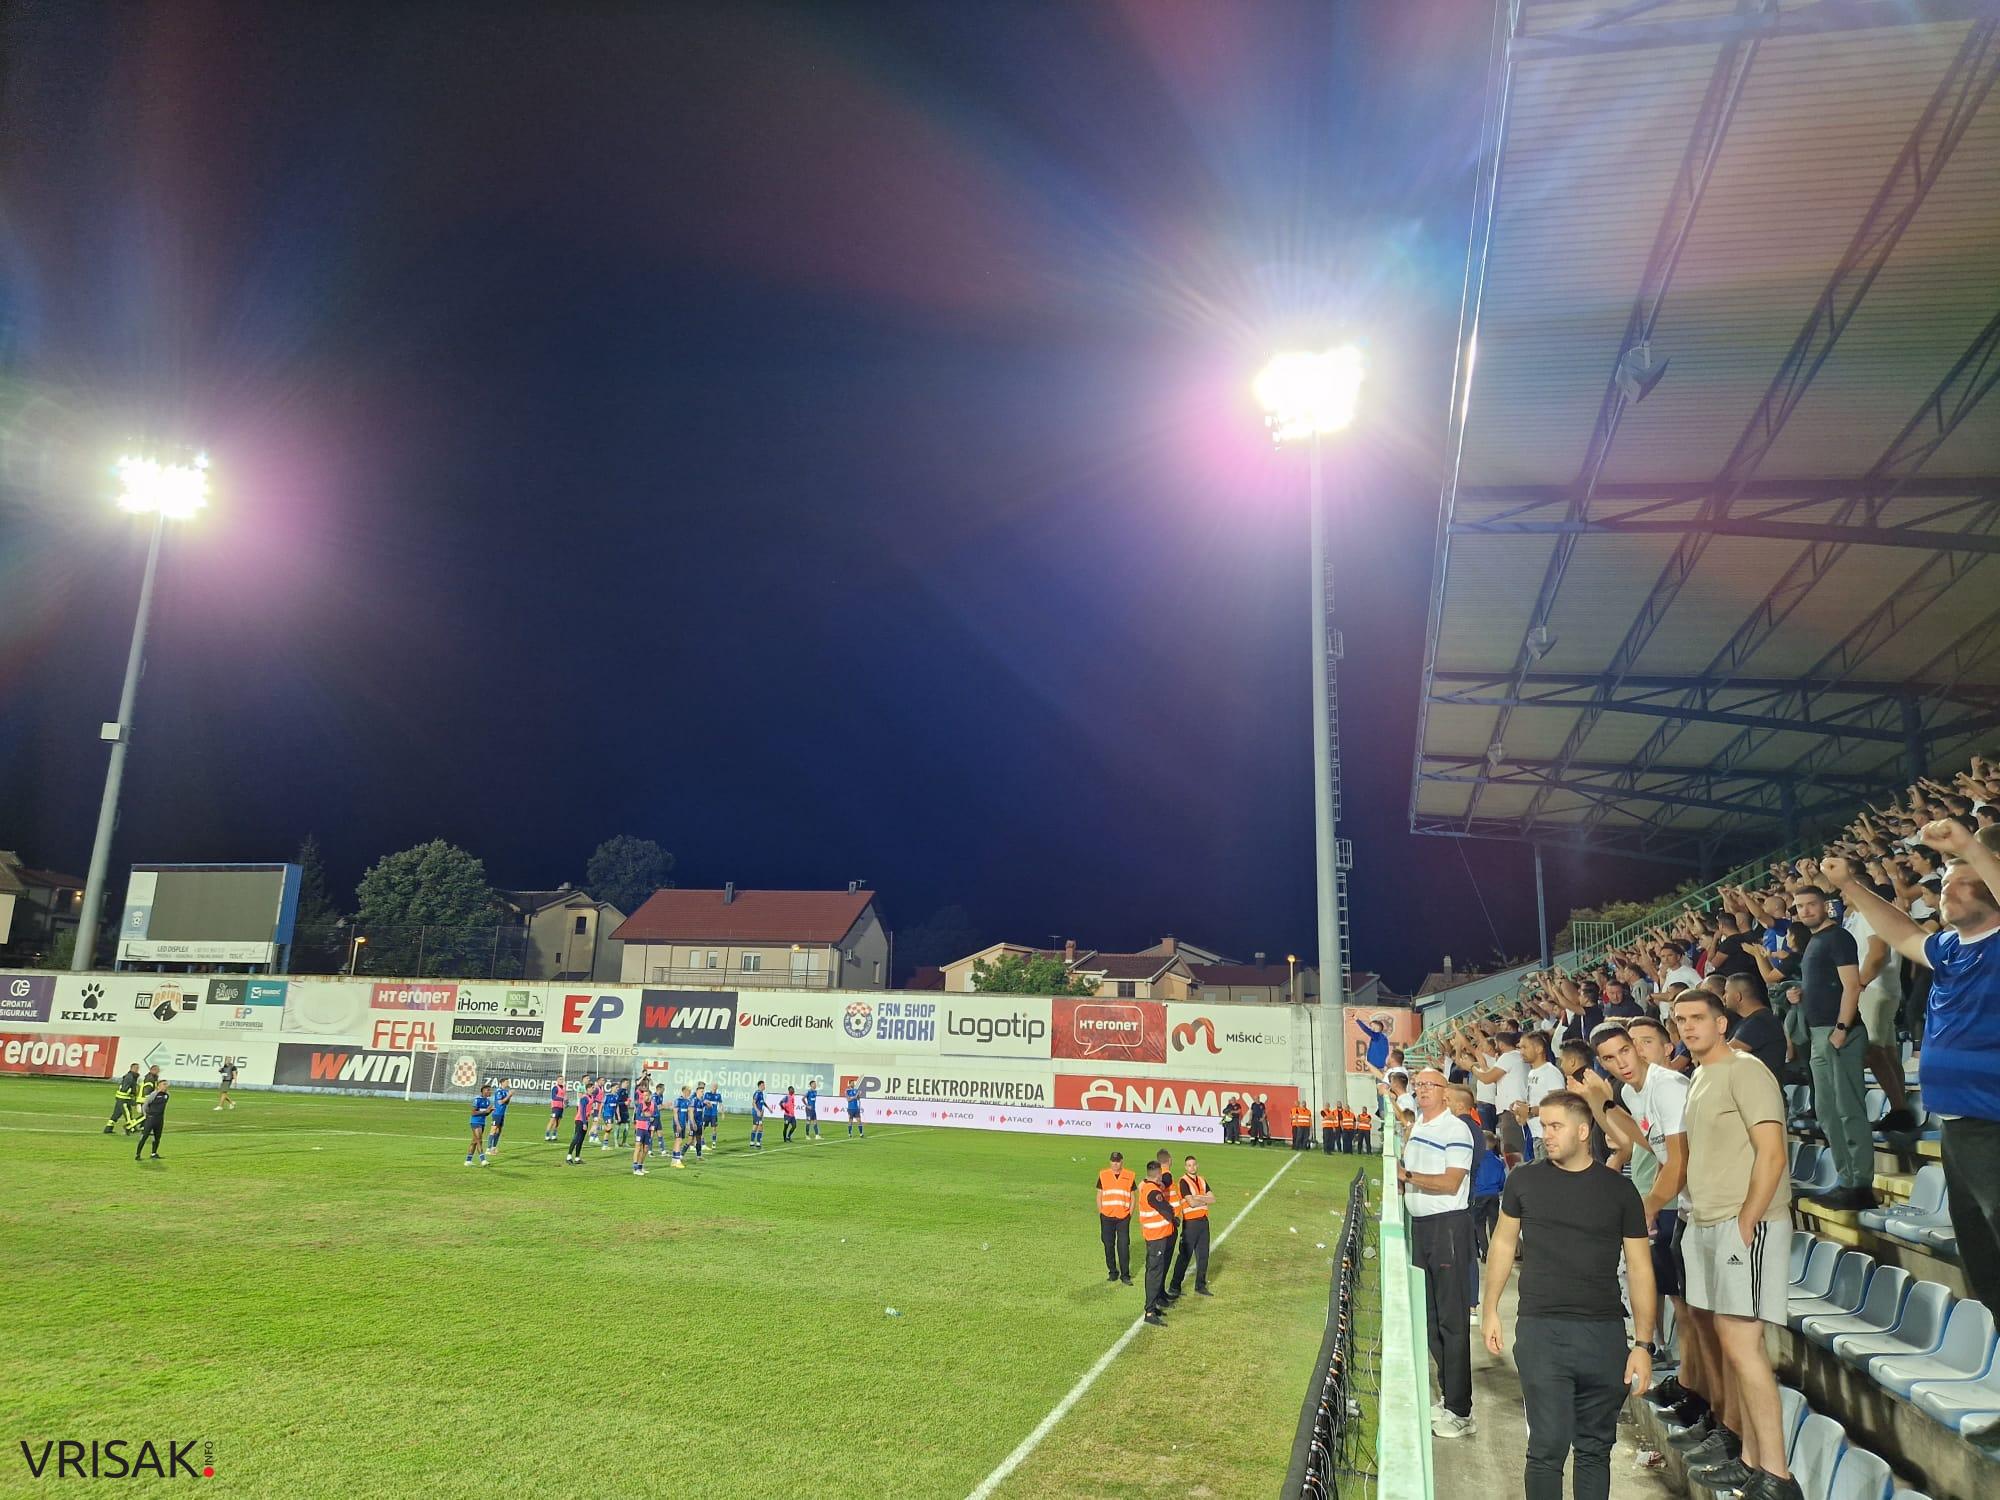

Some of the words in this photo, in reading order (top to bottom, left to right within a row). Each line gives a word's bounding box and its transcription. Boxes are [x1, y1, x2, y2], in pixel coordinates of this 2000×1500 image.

[1, 1000, 32, 1008] CROATIA
[458, 997, 499, 1012] iHome
[878, 1002, 901, 1017] FAN
[905, 1003, 936, 1018] SHOP
[61, 1011, 118, 1022] KELME
[561, 994, 625, 1034] EP
[752, 1014, 803, 1028] UniCredit
[805, 1016, 834, 1029] Bank
[454, 1024, 505, 1035] BUDUĆNOST
[505, 1027, 515, 1036] JE
[515, 1027, 542, 1037] OVDJE
[877, 1017, 935, 1041] ŠIROKI
[948, 1010, 1045, 1044] Logotip
[372, 1020, 438, 1051] FEAL
[1226, 1031, 1263, 1044] MIŠKIĆ
[1264, 1035, 1287, 1045] BUS
[602, 1046, 640, 1056] BRIJEG
[674, 1068, 713, 1085] GRAD
[718, 1067, 767, 1088] ŠIROKI
[771, 1073, 824, 1090] BRIJEG
[885, 1077, 901, 1094] JP
[907, 1078, 1045, 1101] ELEKTROPRIVREDA
